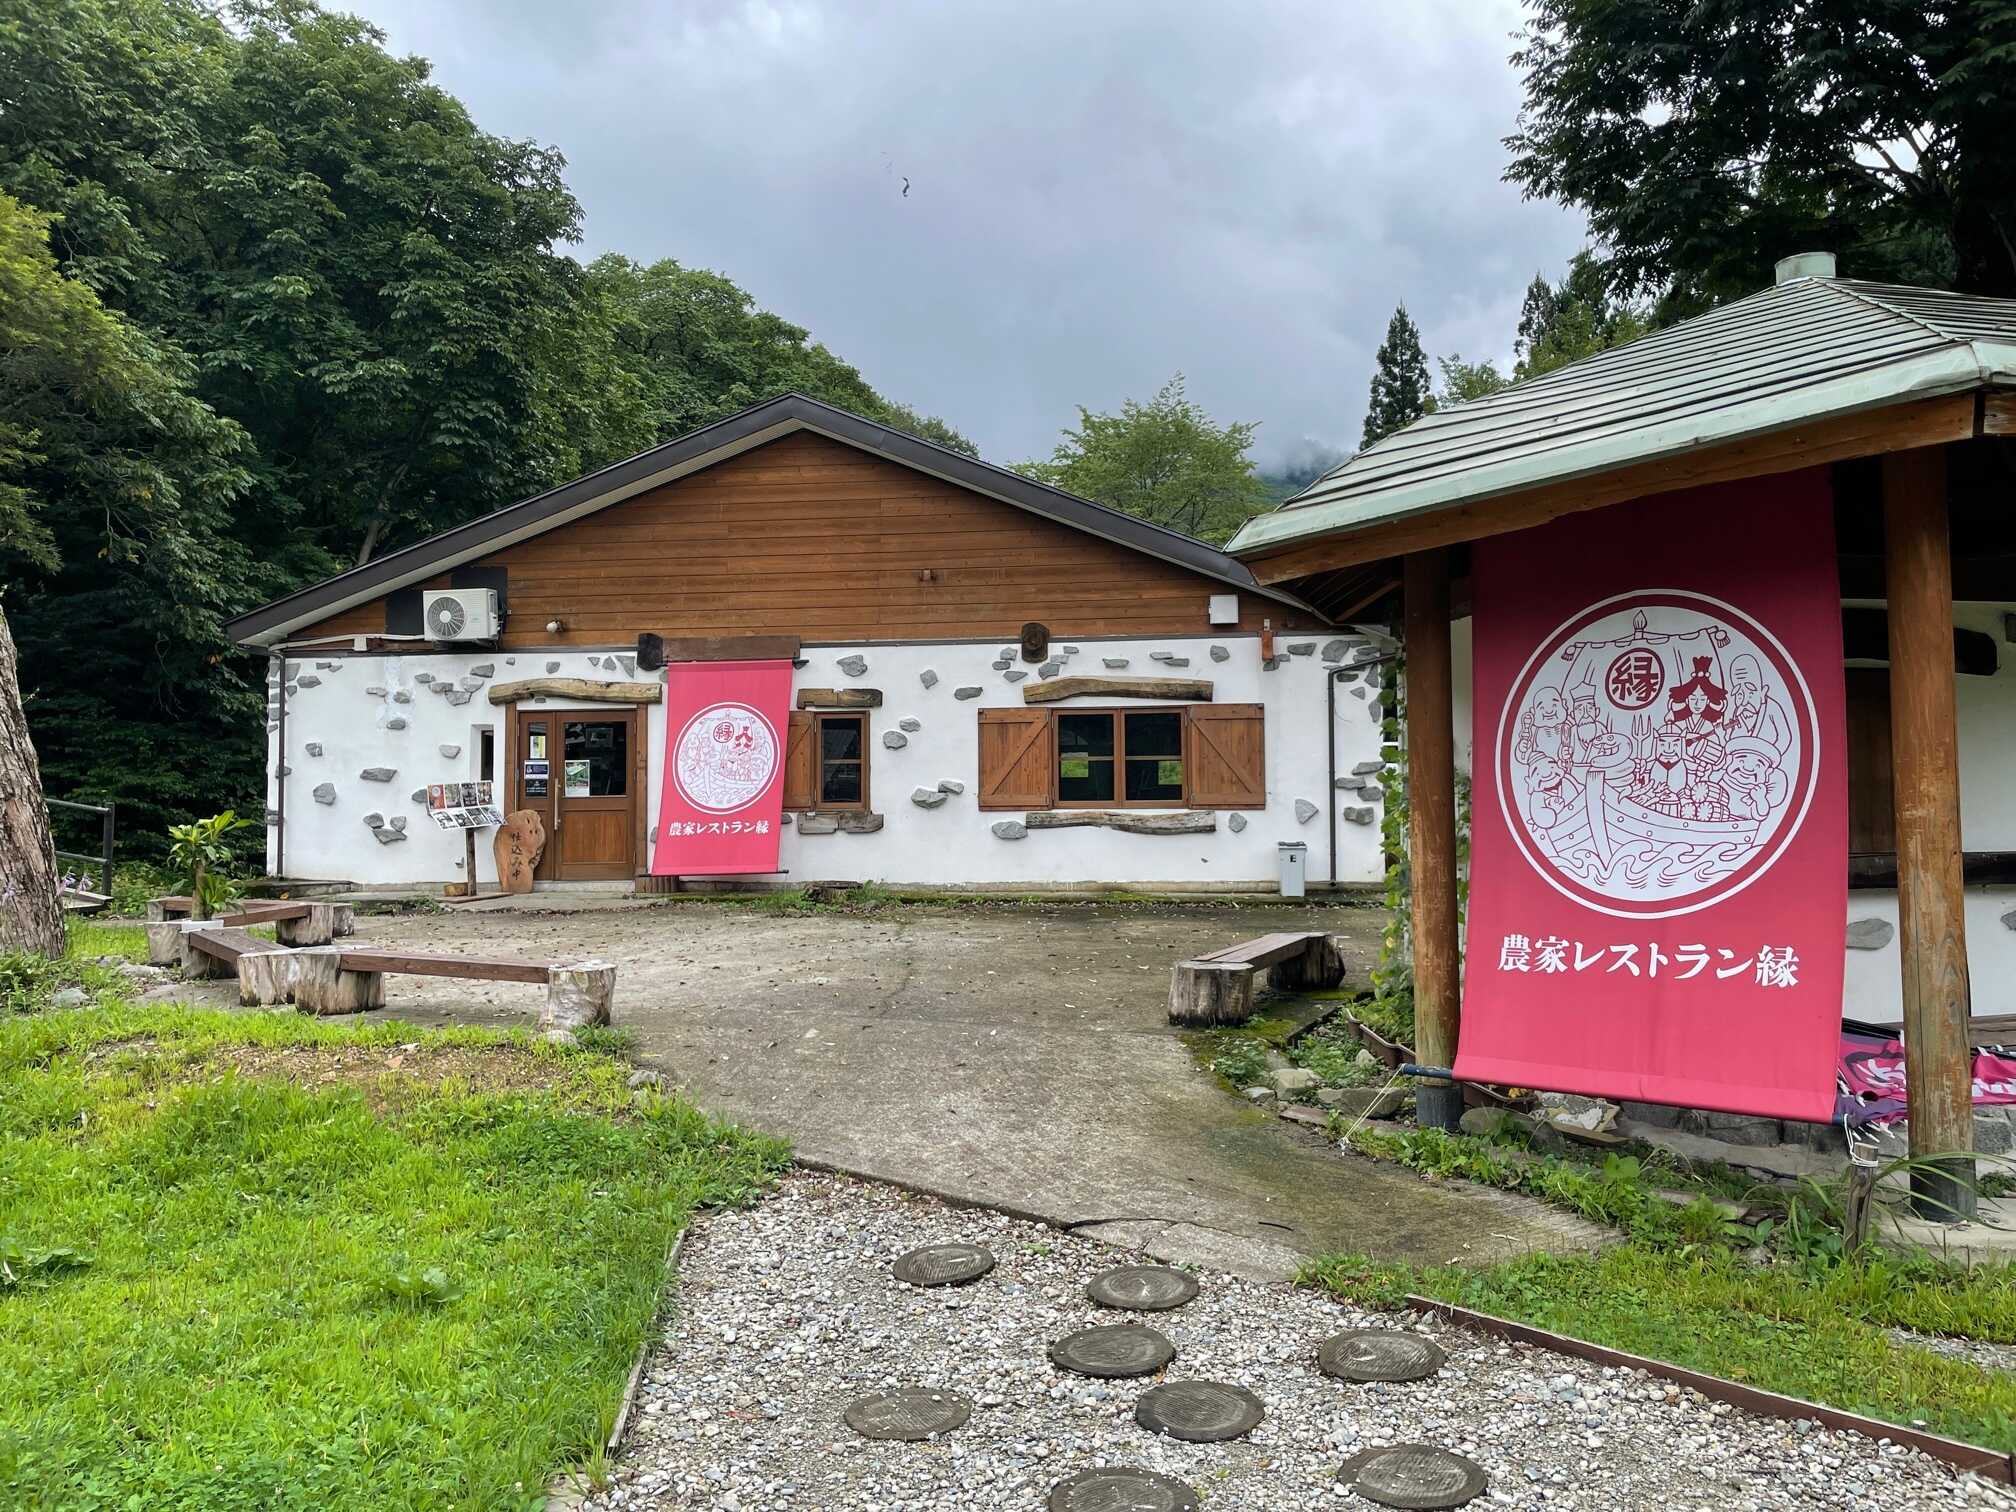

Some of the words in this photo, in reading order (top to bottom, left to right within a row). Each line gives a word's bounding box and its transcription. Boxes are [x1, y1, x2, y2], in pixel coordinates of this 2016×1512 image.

[1611, 655, 1659, 702] 縁
[669, 820, 769, 836] 農家レストラン縁
[511, 831, 523, 881] 仕込み中
[1497, 934, 1800, 988] 農家レストラン縁
